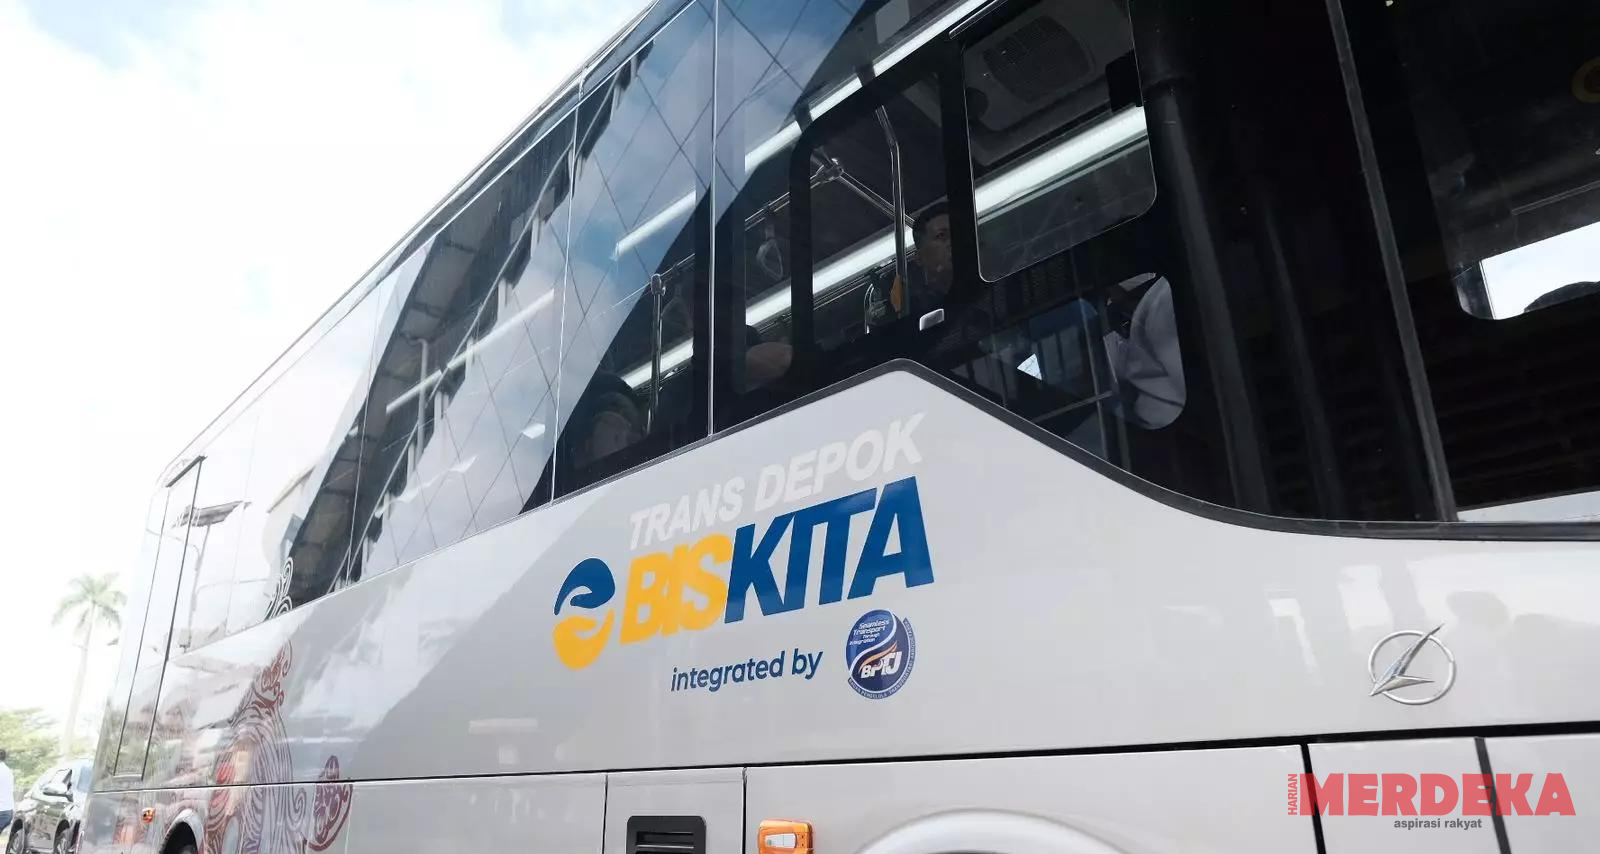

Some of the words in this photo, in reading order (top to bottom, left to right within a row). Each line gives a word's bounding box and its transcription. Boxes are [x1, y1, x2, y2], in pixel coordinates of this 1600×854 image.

[629, 476, 747, 550] TRANS
[754, 411, 927, 513] DEPOK
[619, 475, 935, 645] BISKITA
[853, 626, 885, 635] Transport
[859, 620, 889, 629] Seamless
[670, 649, 786, 692] integrated
[791, 648, 823, 680] by
[860, 651, 902, 678] BPTJ
